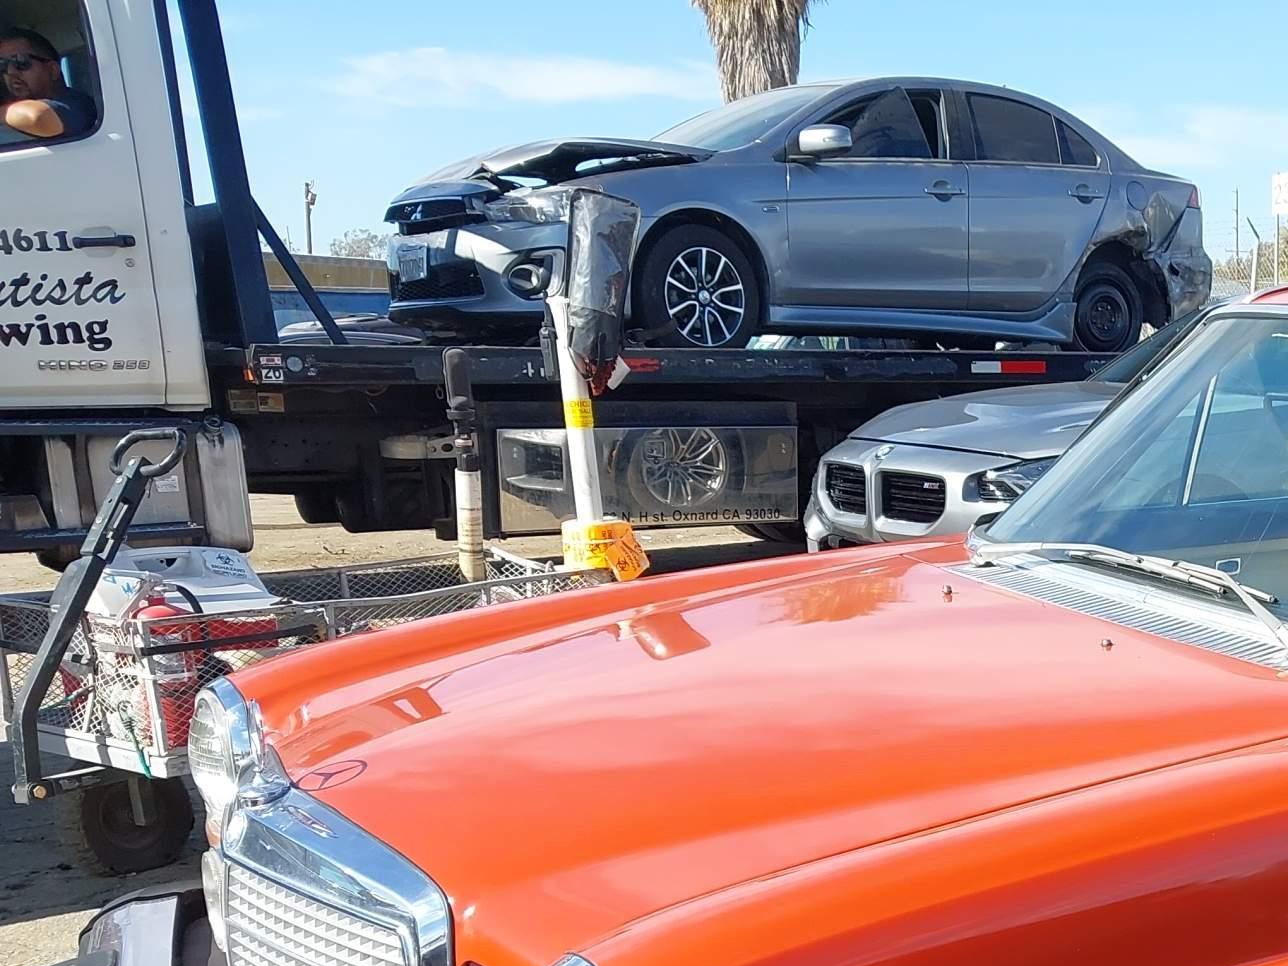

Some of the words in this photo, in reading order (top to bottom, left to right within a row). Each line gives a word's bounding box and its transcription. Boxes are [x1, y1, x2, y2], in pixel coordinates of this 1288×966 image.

[0, 271, 126, 308] tista
[38, 359, 108, 371] HINO
[639, 511, 649, 522] H
[672, 509, 718, 521] Oxnard
[722, 508, 741, 520] CA
[745, 508, 780, 520] 93030
